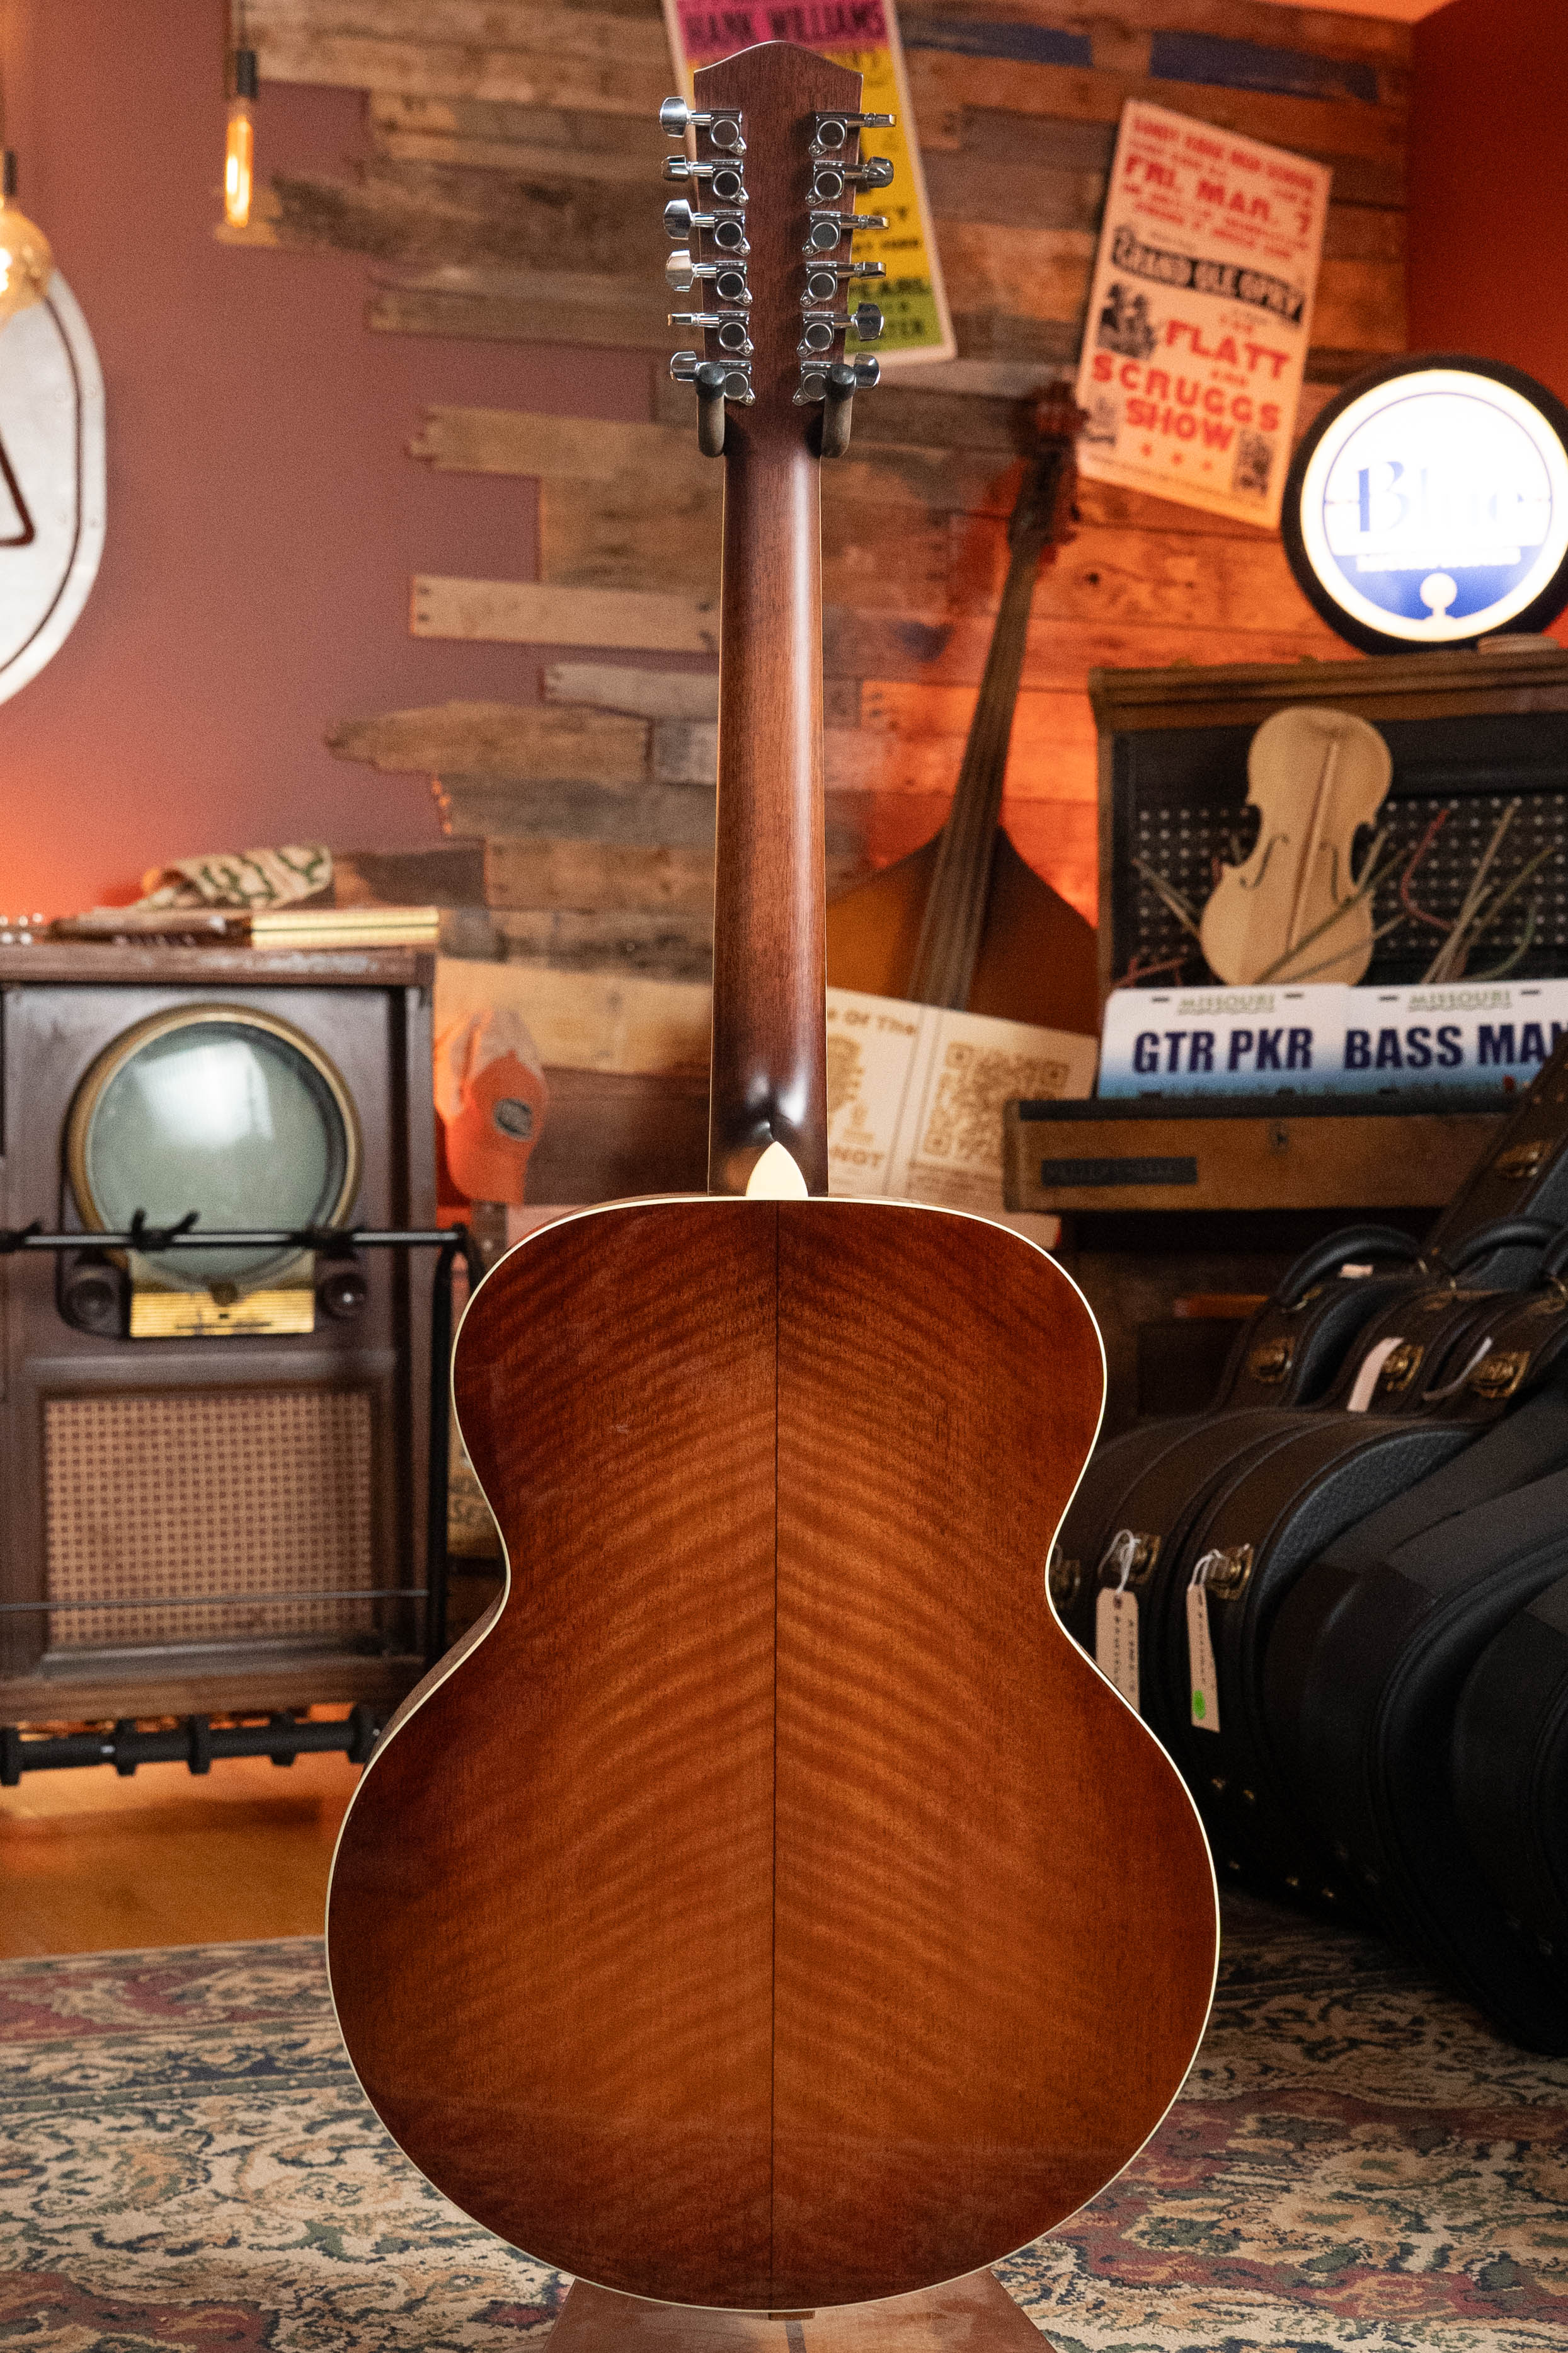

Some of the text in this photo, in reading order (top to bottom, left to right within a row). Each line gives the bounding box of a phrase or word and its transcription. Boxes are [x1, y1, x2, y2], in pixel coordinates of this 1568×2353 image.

[1165, 319, 1290, 378] FLATT
[1093, 354, 1281, 432] SCRUGGS
[1126, 398, 1235, 453] SHOW
[1135, 1027, 1313, 1072] GTR PKR
[1344, 1025, 1464, 1071] BASS
